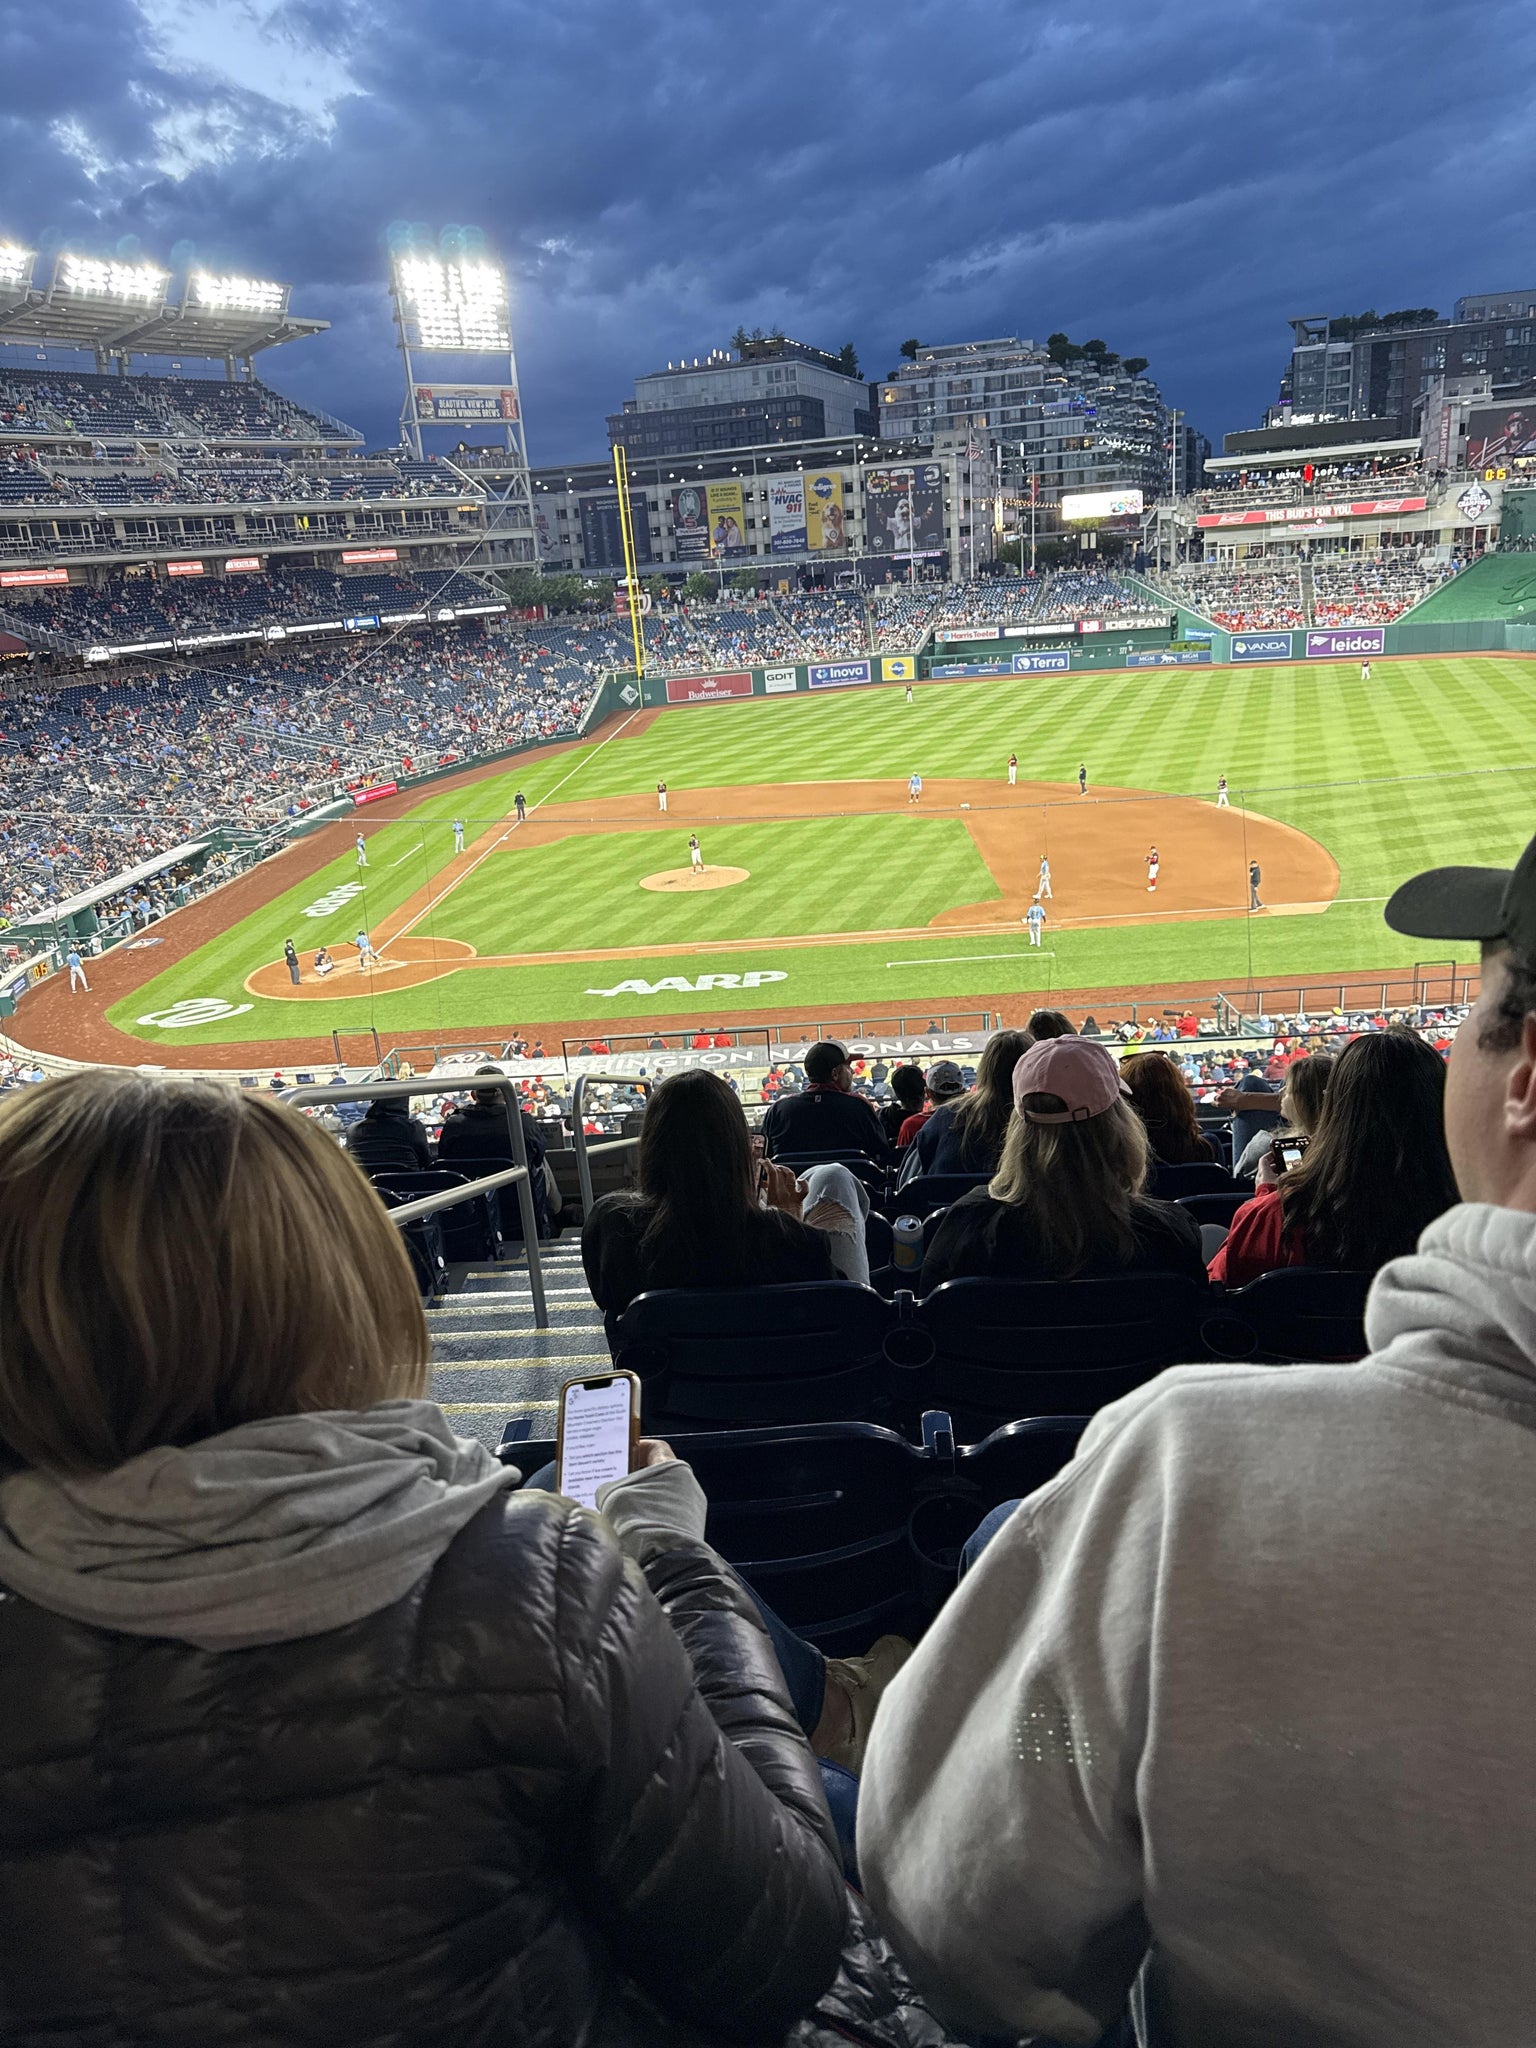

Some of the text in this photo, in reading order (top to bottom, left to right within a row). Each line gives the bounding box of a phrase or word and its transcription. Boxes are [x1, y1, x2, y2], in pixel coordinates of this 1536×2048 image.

[439, 400, 467, 409] BEAUTIFUL
[468, 400, 485, 408] VIEWS
[485, 400, 497, 408] AND
[438, 408, 500, 417] AWARD WINNING BREWS
[1441, 418, 1449, 439] TEAM
[1439, 441, 1448, 463] STORE
[1315, 468, 1338, 477] LOFT
[809, 482, 837, 492] Pedigree
[775, 493, 802, 505] HVAC
[786, 503, 802, 513] 911
[1264, 511, 1285, 520] THIS
[1286, 508, 1313, 519] BUD'S
[1314, 506, 1332, 517] FOR
[1136, 617, 1167, 628] FAN
[950, 632, 973, 640] Harris
[973, 630, 997, 638] Teeter
[1247, 641, 1288, 650] VANDA
[1331, 636, 1381, 652] leidos
[1031, 657, 1065, 669] Terra
[766, 672, 794, 681] GDIT
[830, 666, 864, 678] Inova
[688, 688, 732, 700] Budweiser
[583, 970, 789, 997] AARP
[507, 1036, 974, 1076] WASHINGTON NAONALS
